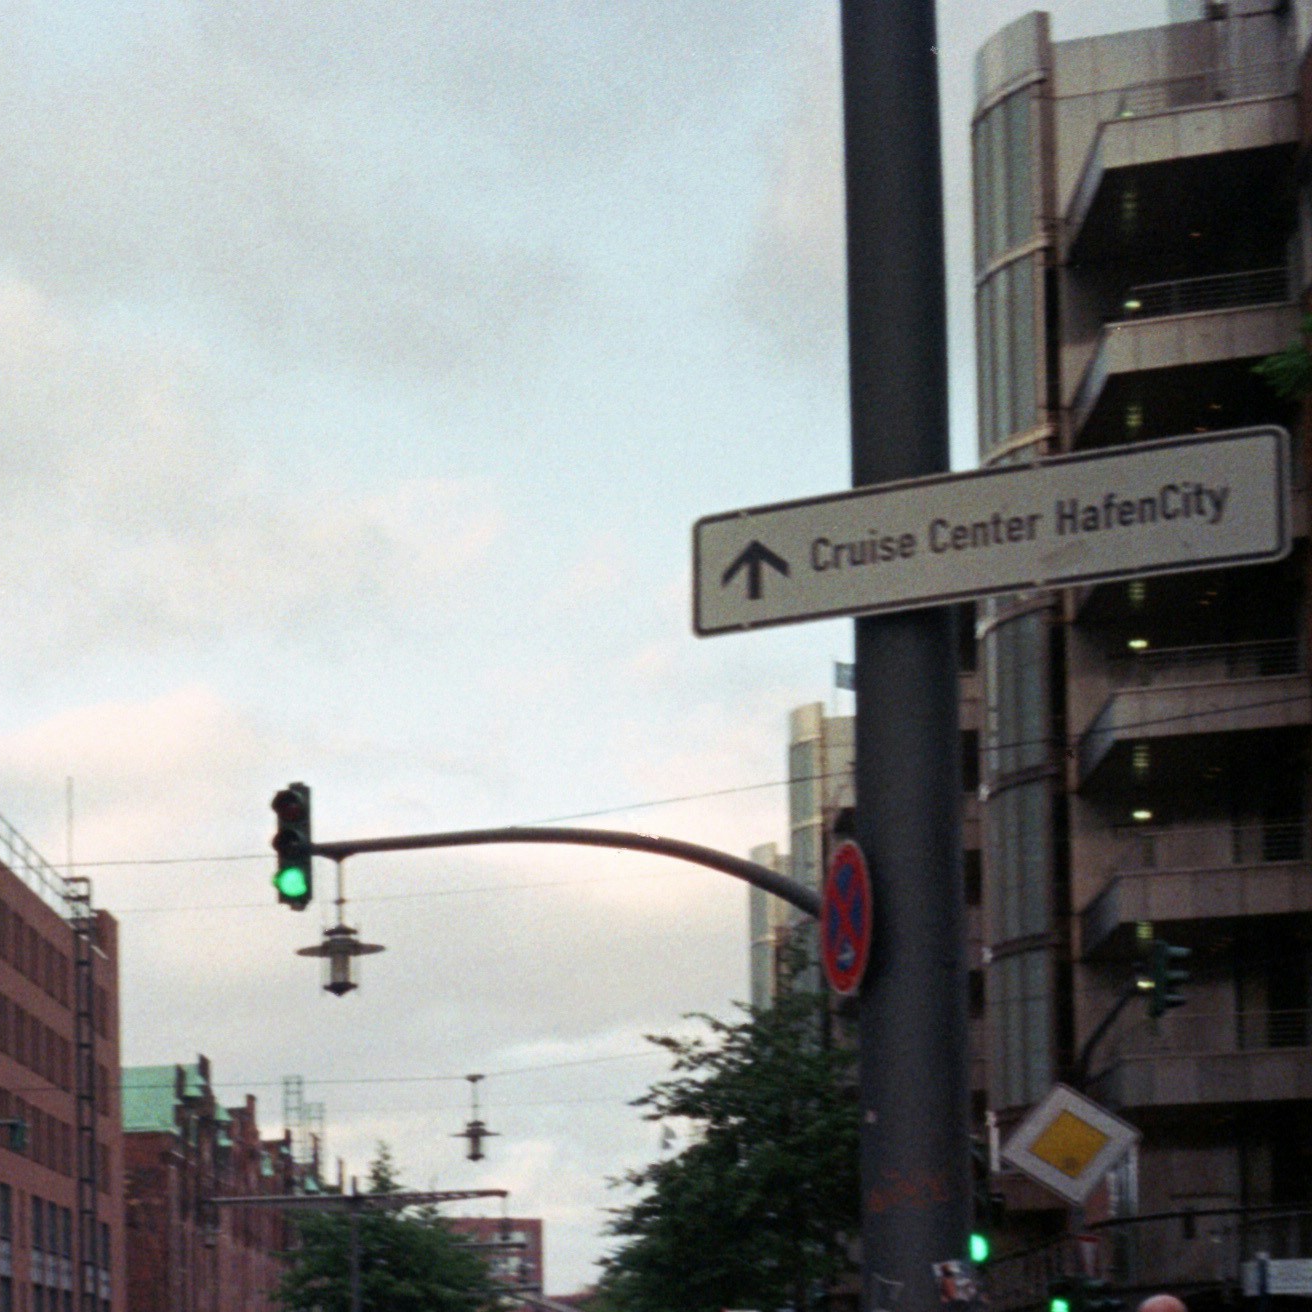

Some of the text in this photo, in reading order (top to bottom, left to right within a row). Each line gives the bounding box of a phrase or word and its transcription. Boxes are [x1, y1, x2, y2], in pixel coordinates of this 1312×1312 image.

[809, 482, 1232, 573] Cruise Center HafenCity
